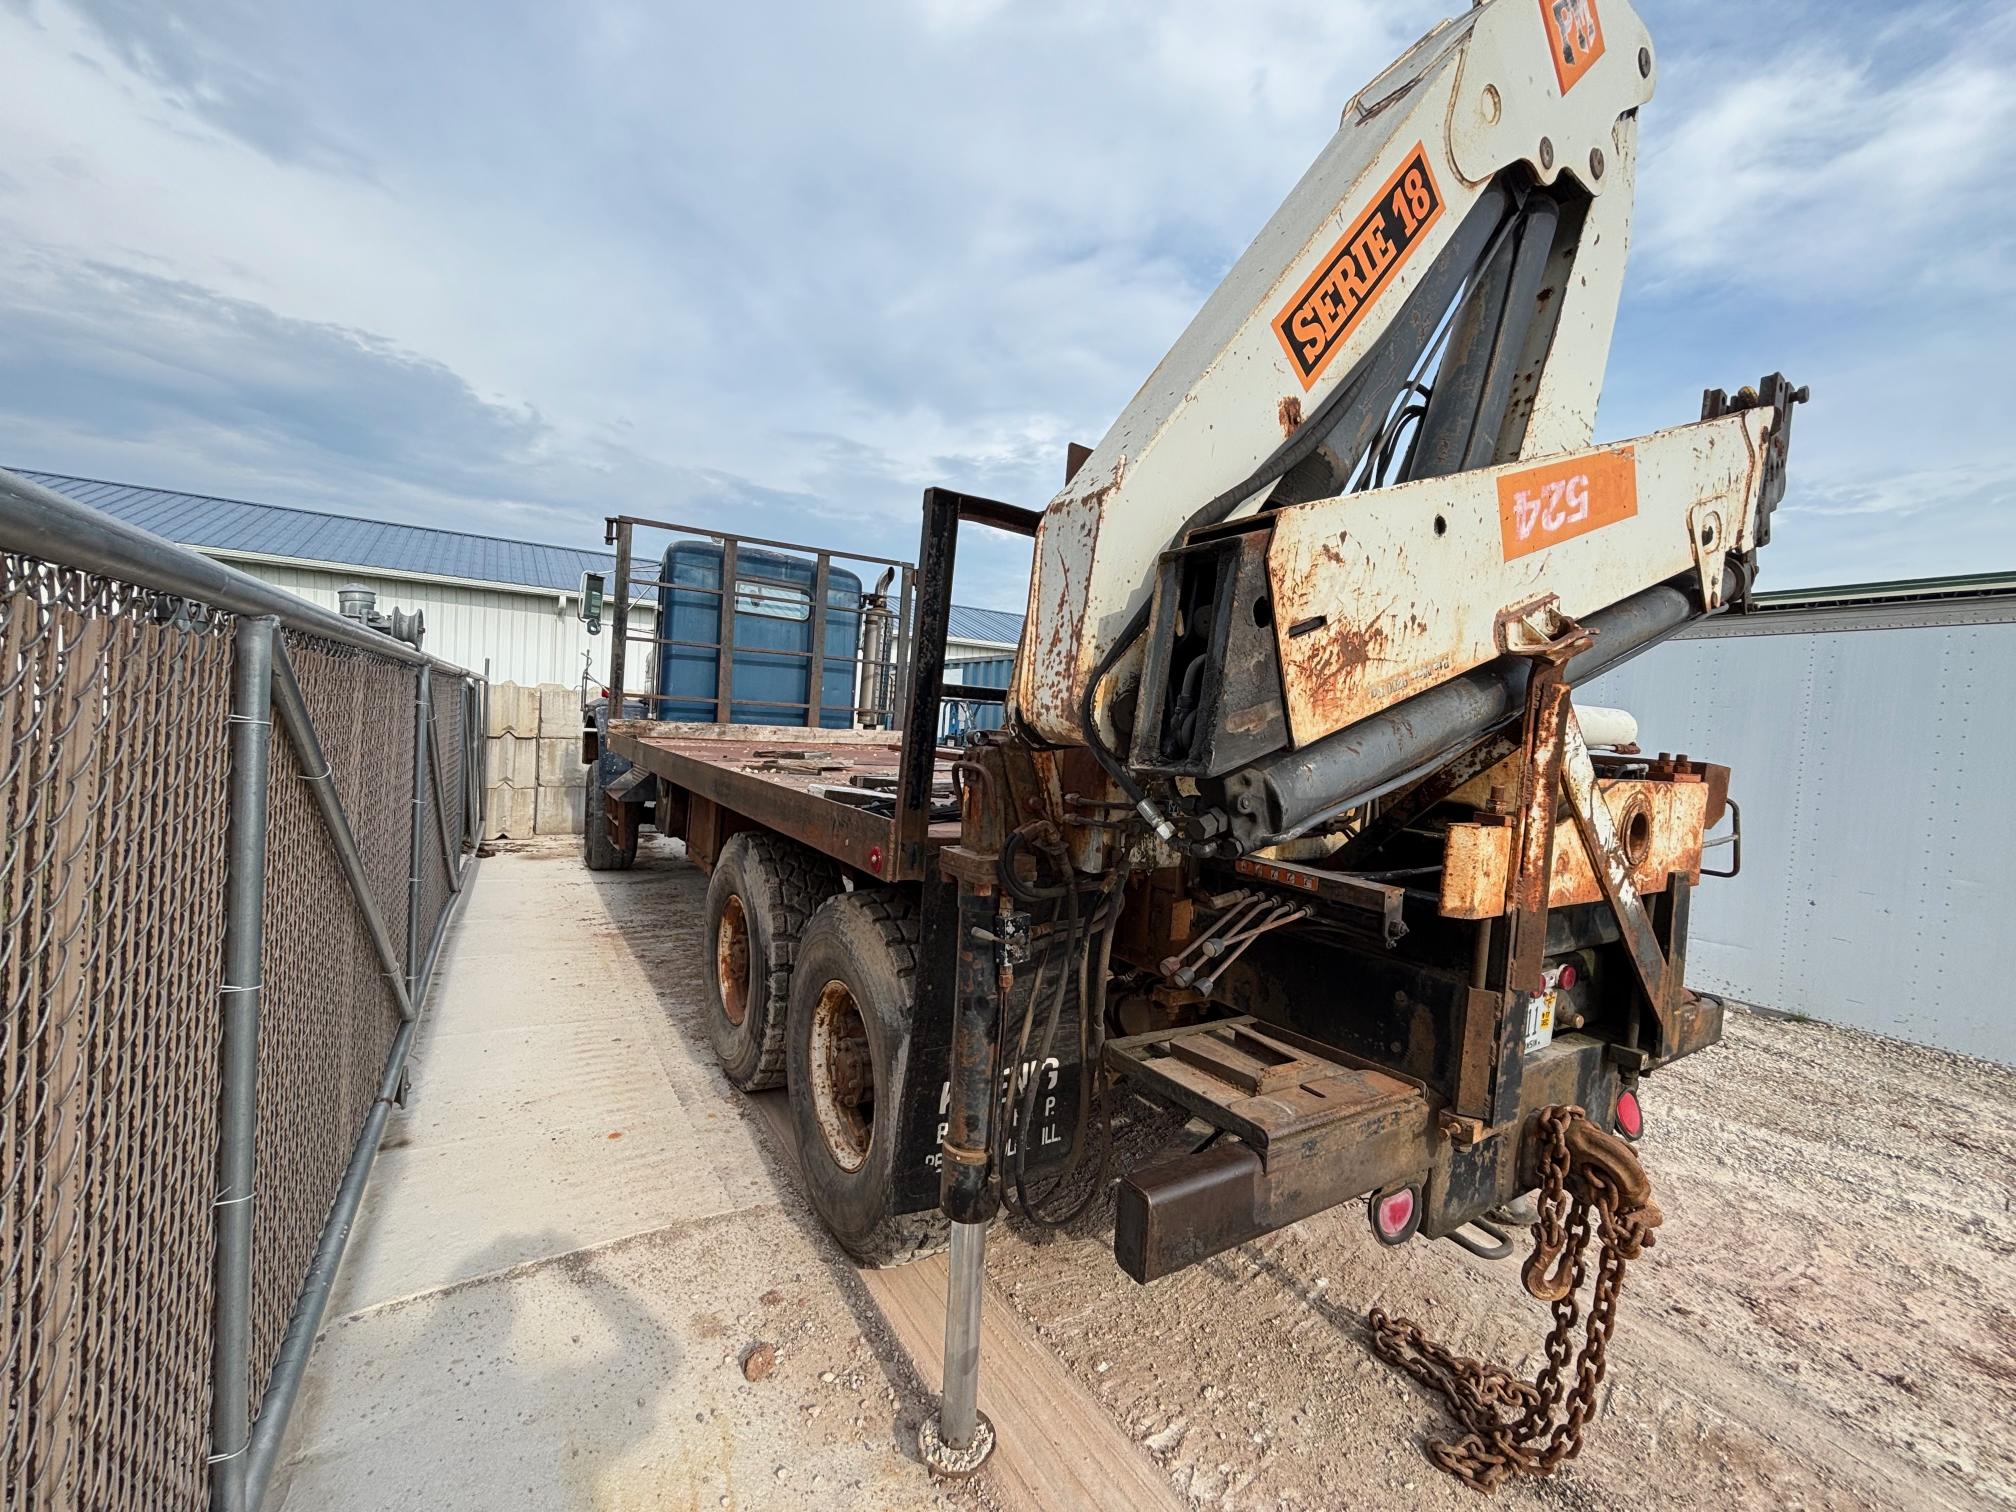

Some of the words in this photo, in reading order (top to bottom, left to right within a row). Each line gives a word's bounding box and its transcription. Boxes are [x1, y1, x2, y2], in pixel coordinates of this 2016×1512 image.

[1292, 211, 1398, 365] SERIE
[1392, 168, 1430, 238] 18
[1513, 474, 1589, 542] 524
[1041, 1123, 1062, 1146] ILL.
